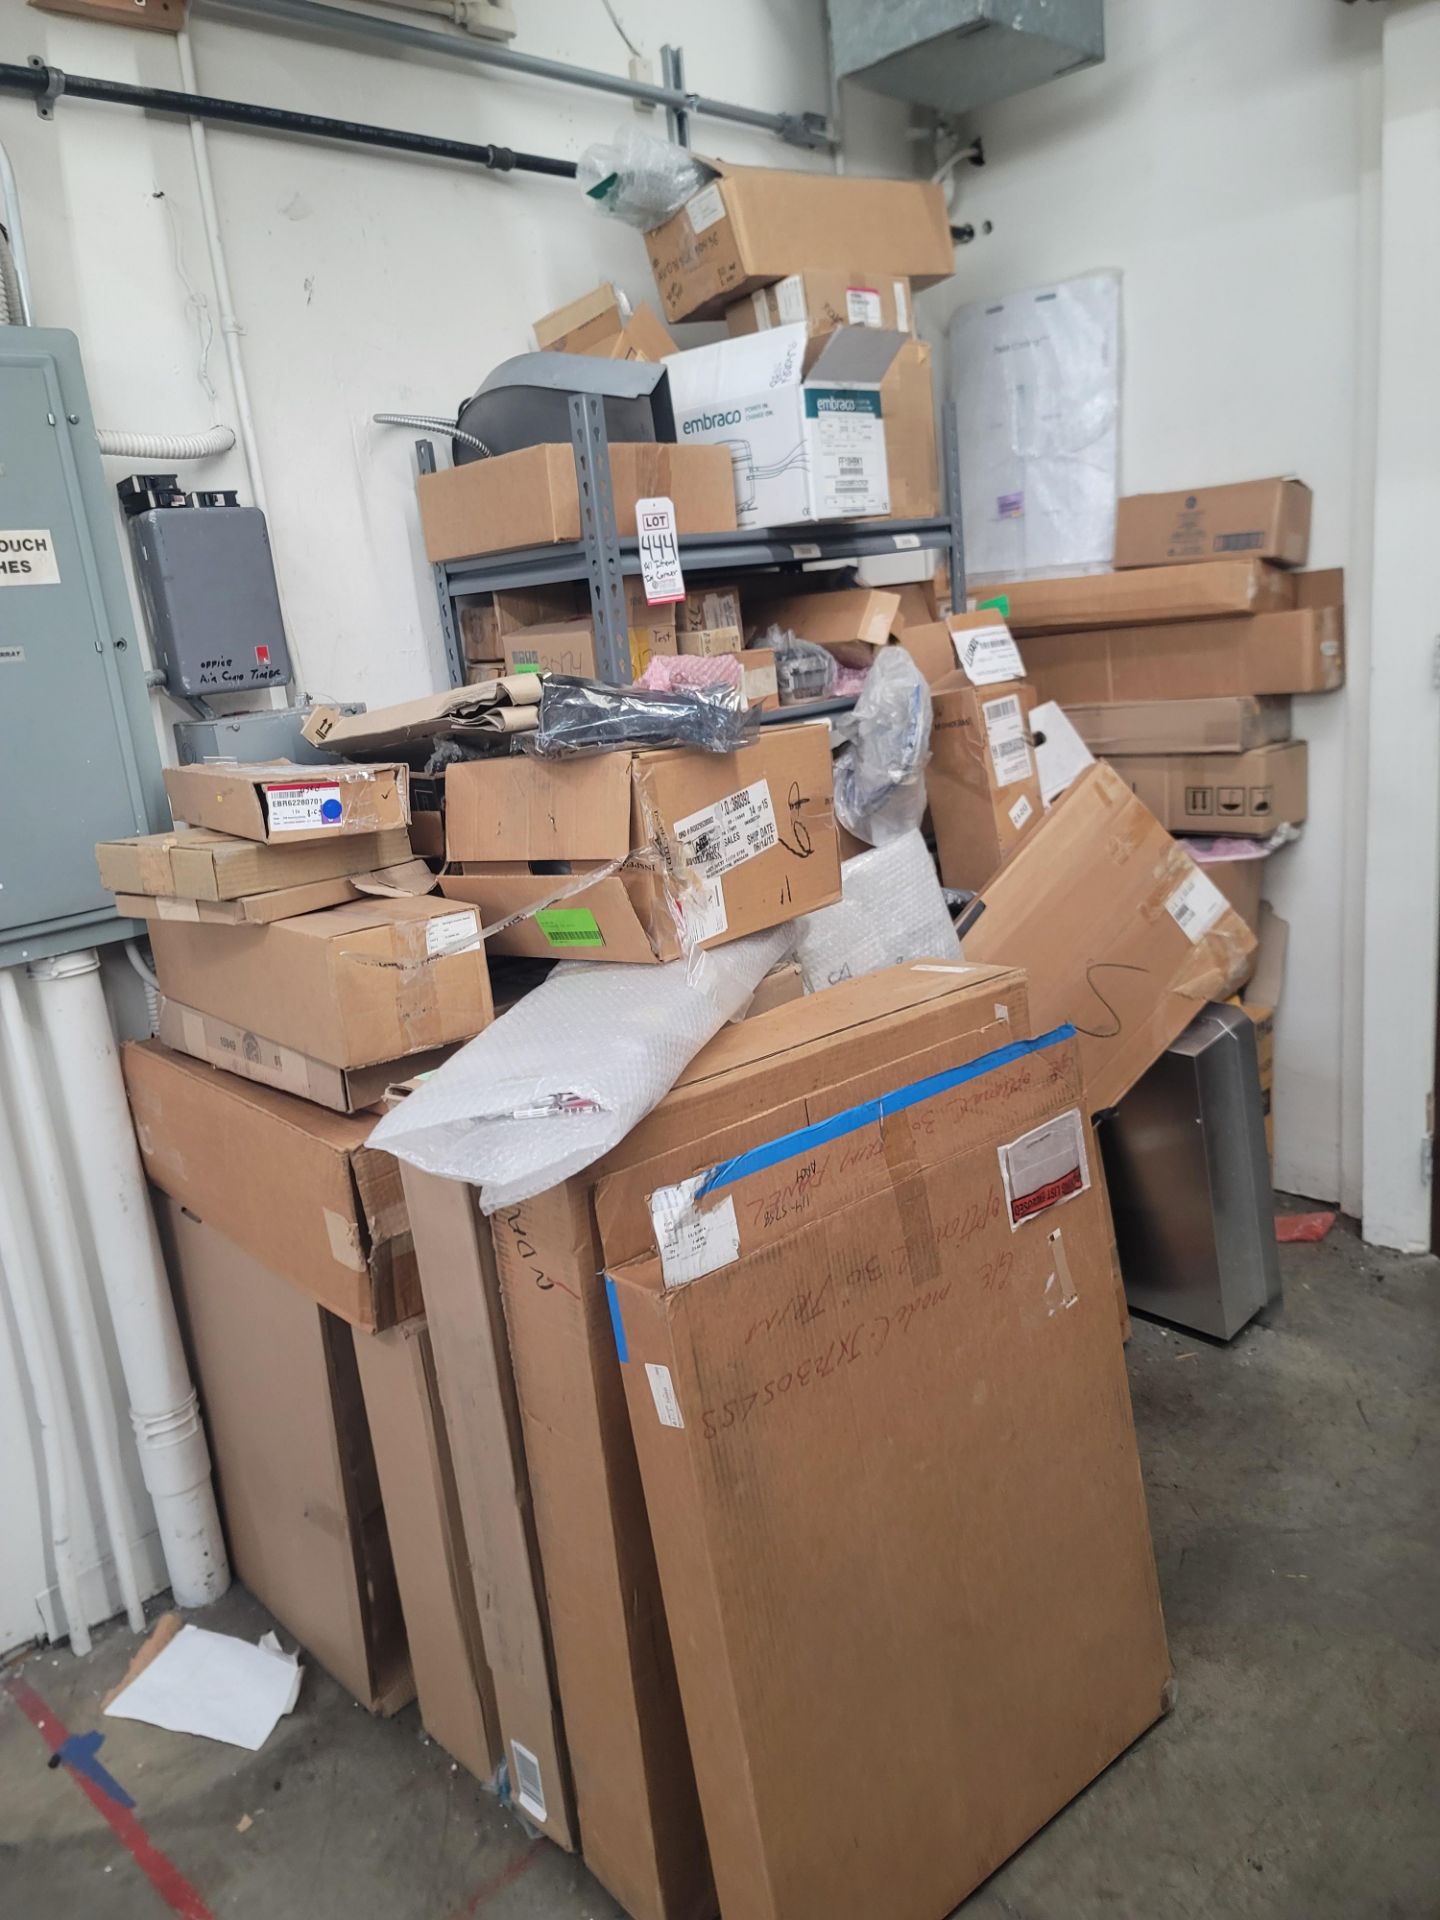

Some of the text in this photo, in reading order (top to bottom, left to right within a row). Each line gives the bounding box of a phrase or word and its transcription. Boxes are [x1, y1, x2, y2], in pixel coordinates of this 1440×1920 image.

[817, 396, 856, 411] embraco
[682, 409, 742, 435] embraco
[645, 516, 666, 527] LOT
[641, 532, 678, 561] 444
[723, 831, 741, 847] SALES
[1047, 1185, 1060, 1200] LIST
